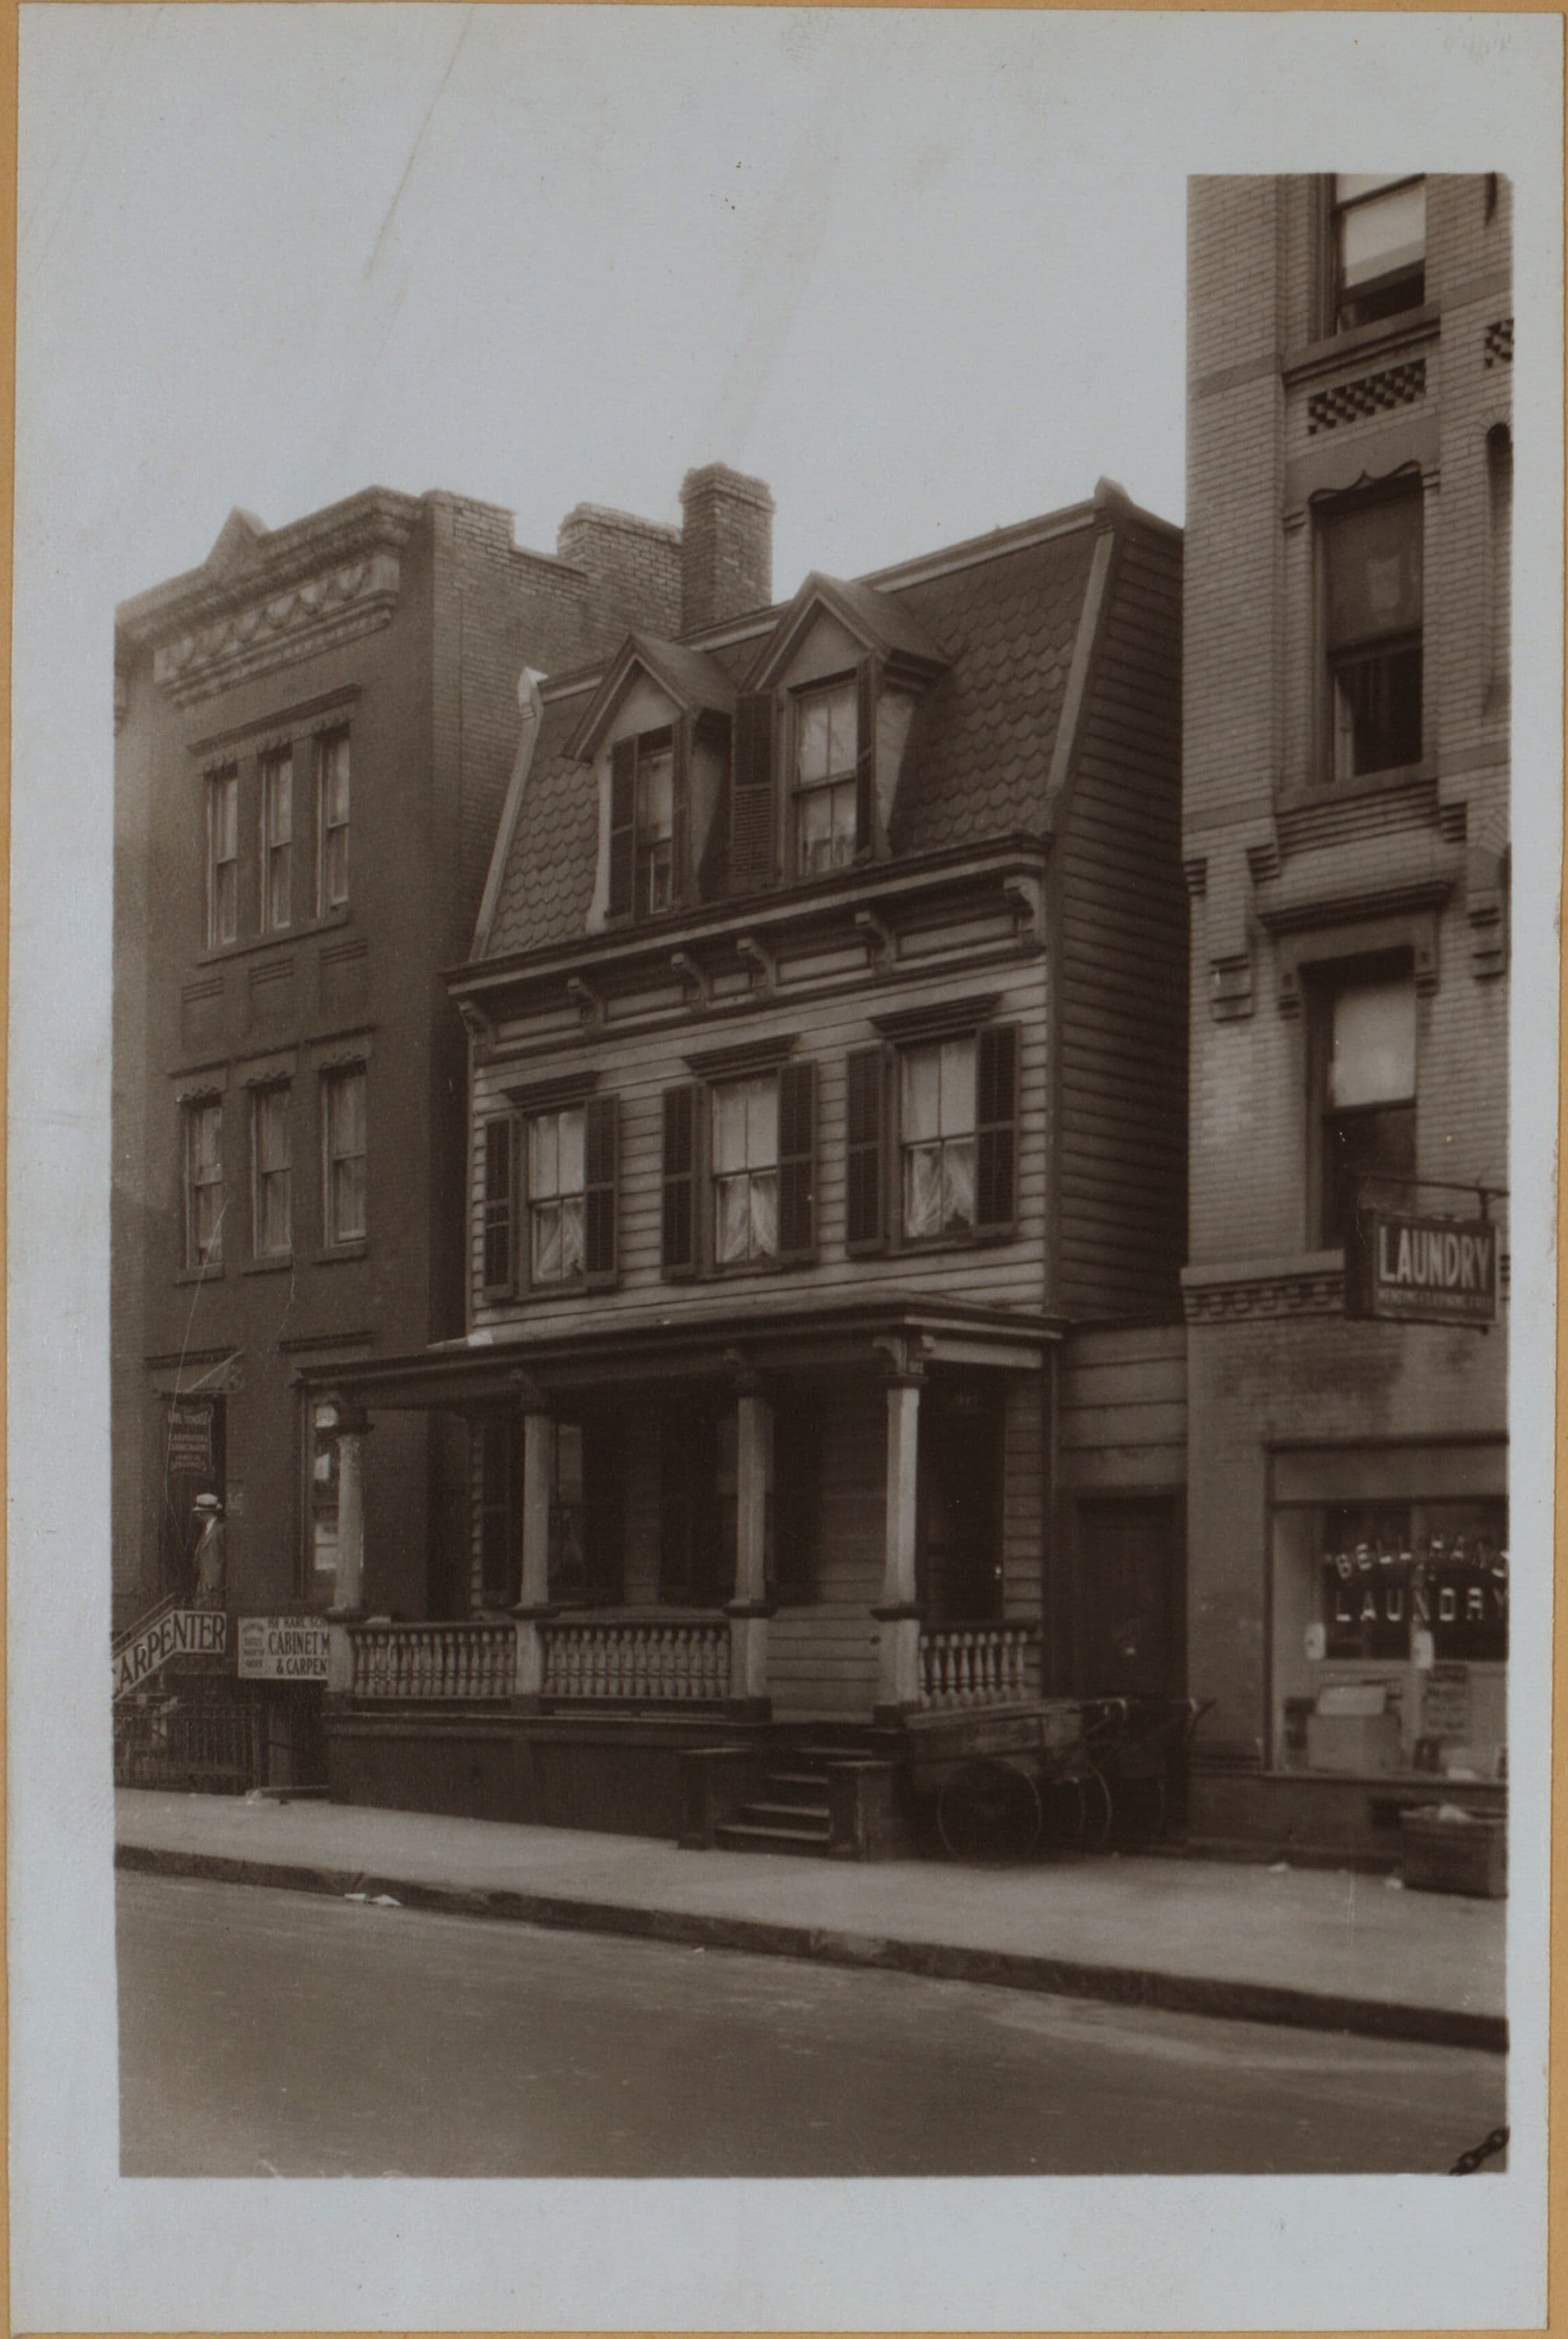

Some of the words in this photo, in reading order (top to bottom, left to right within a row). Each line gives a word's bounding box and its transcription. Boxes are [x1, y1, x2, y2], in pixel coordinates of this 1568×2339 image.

[1379, 1225, 1490, 1290] LAUNDRY
[1336, 1587, 1510, 1622] LAUNDRY
[268, 1631, 318, 1656] CABINET
[276, 1658, 284, 1675] &
